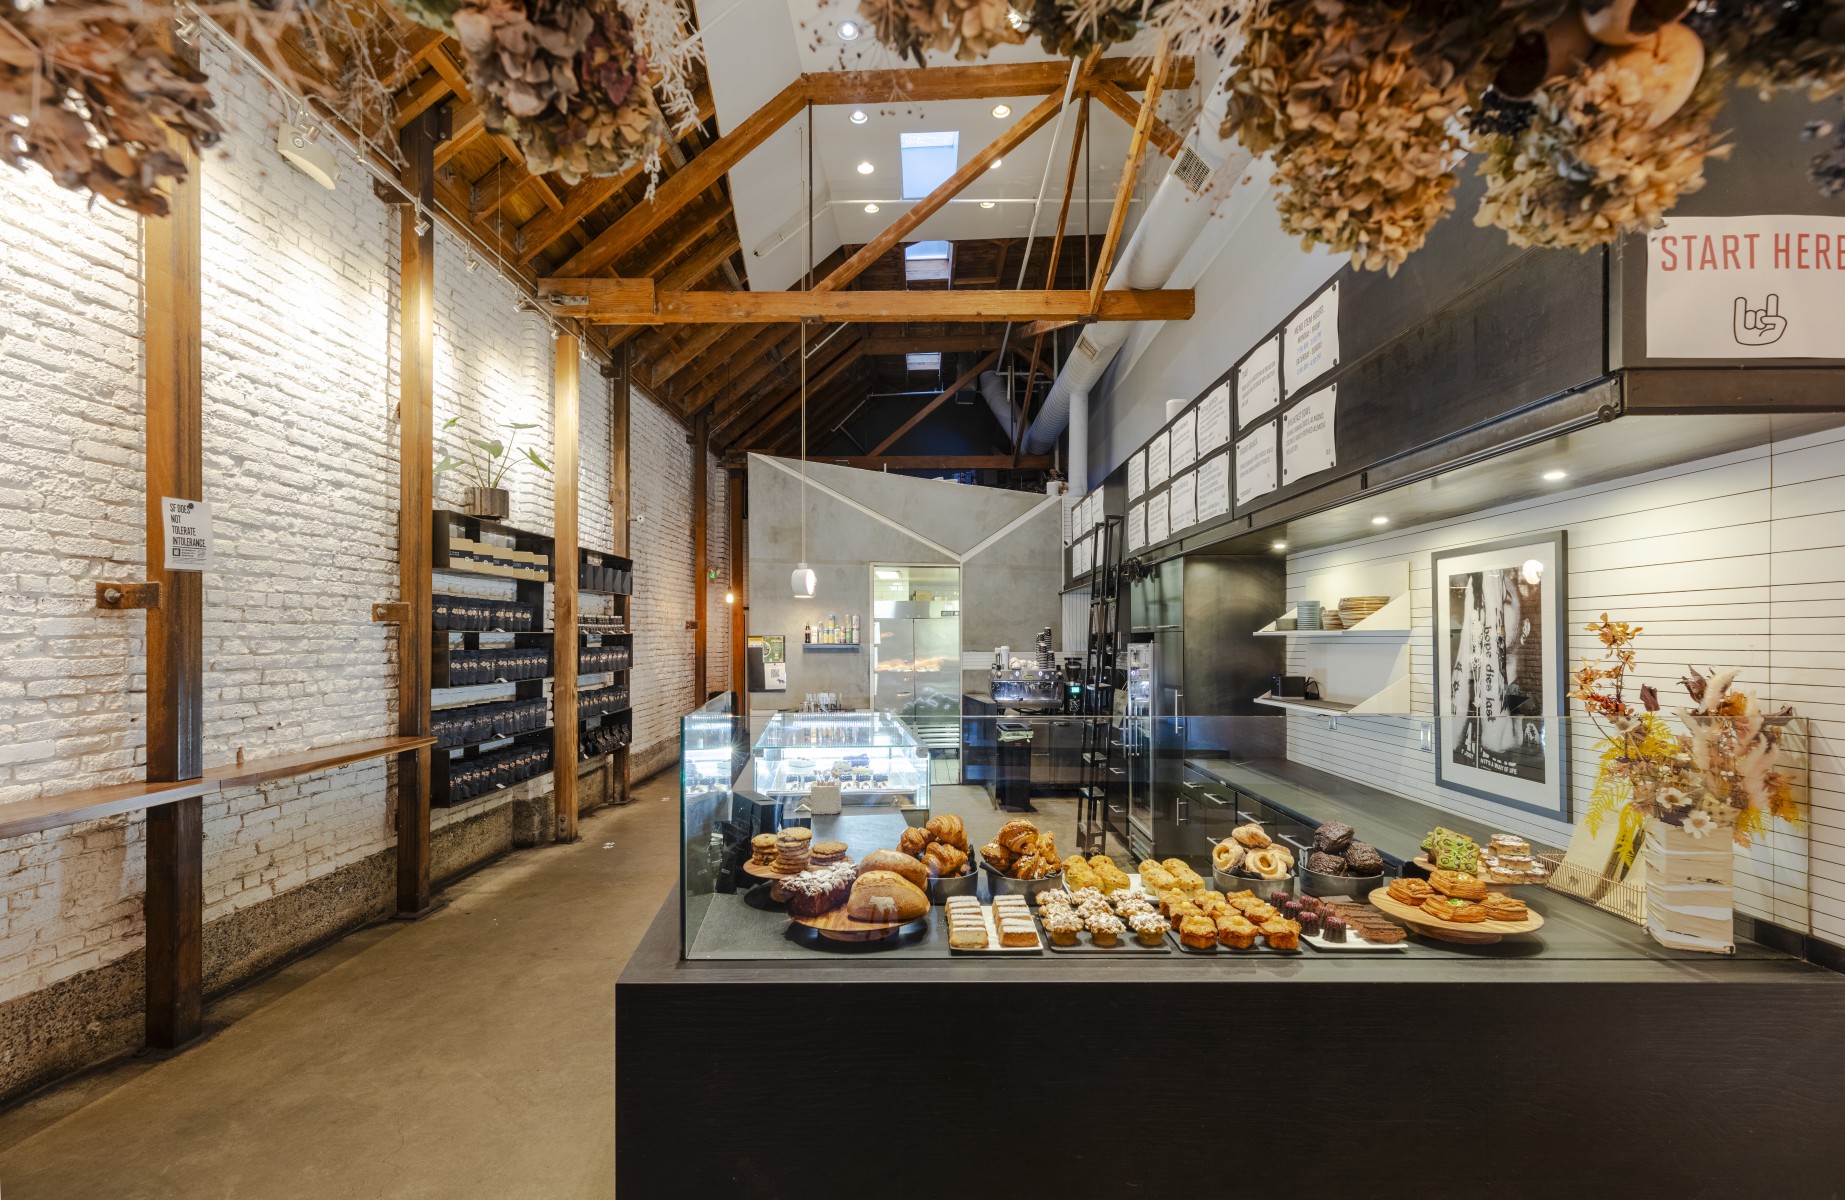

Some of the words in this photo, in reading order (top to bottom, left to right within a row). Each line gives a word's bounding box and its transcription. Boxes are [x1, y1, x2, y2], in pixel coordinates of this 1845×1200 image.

[1661, 233, 1760, 271] START
[1774, 233, 1845, 270] HERE
[170, 503, 176, 512] SF
[177, 504, 191, 514] DOES
[170, 514, 181, 524] NOT
[172, 525, 197, 537] TOLERATE
[1485, 663, 1494, 692] dies
[1485, 697, 1496, 722] last
